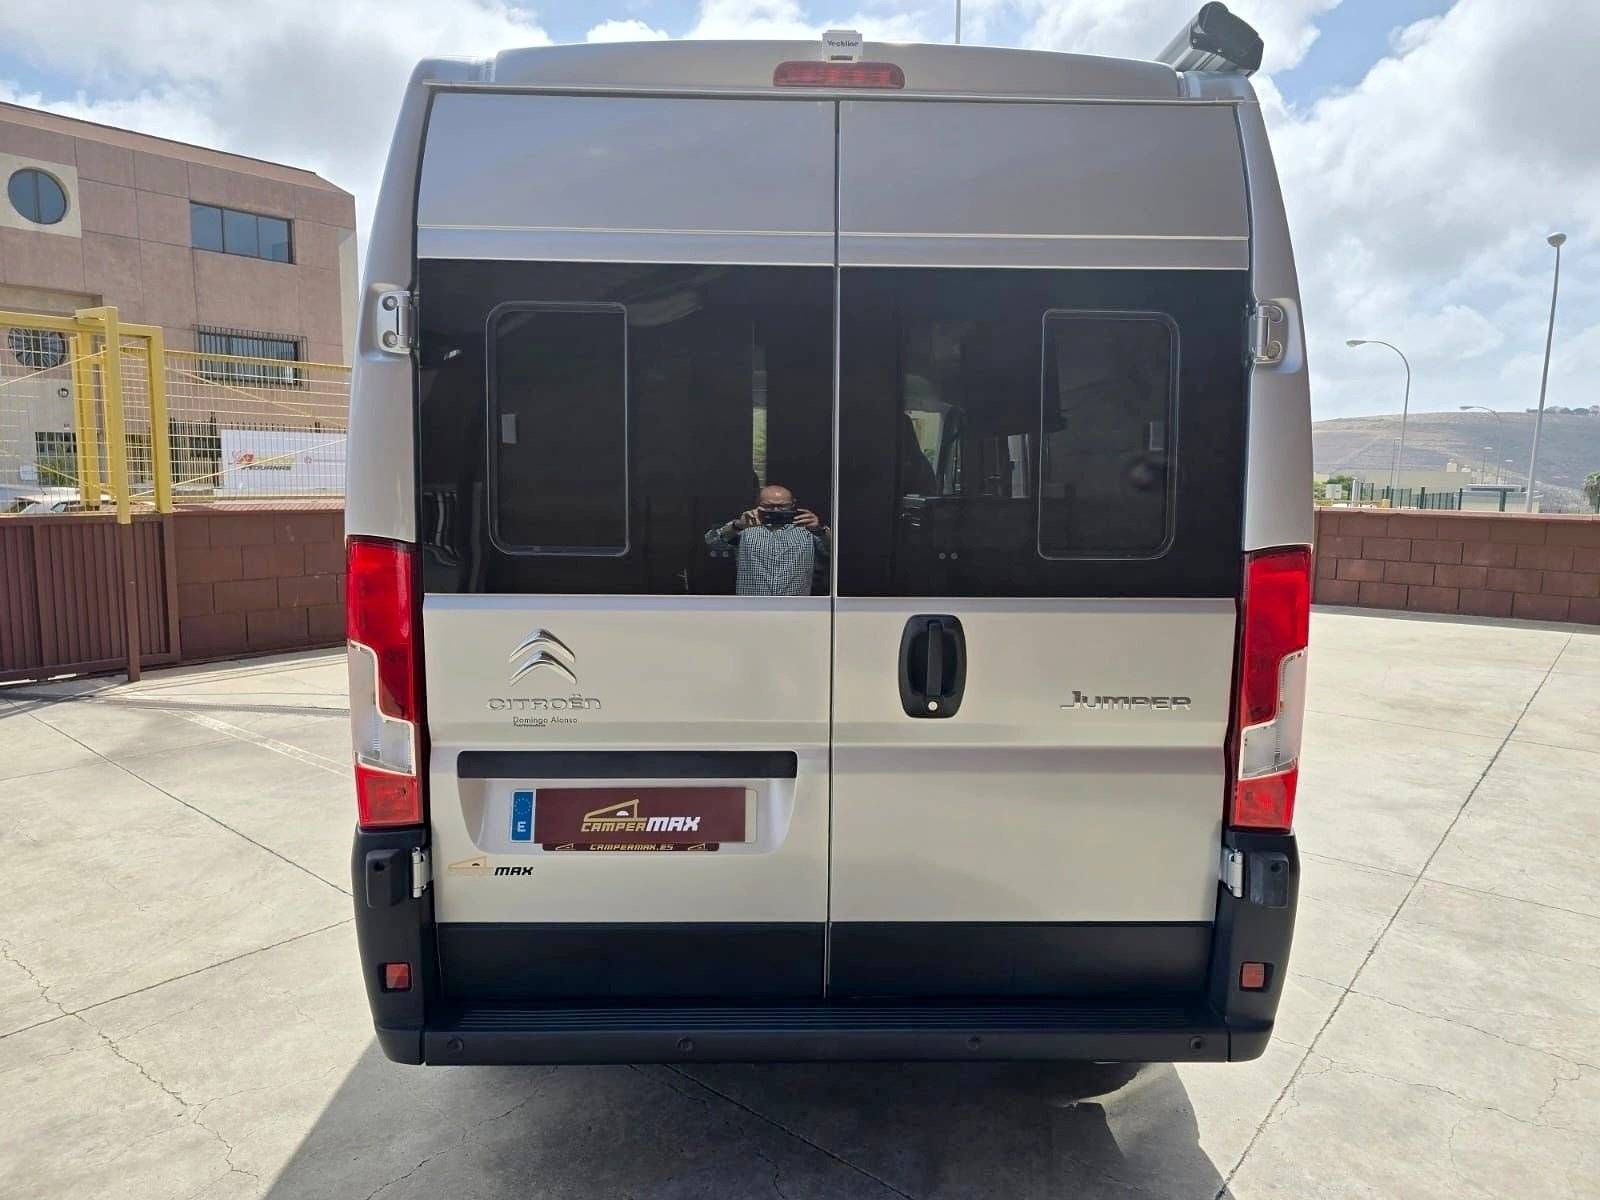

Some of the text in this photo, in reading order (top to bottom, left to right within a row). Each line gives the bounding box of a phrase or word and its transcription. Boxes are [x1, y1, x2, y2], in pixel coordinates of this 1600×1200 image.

[512, 716, 578, 725] Domingo Alonso
[517, 821, 527, 832] E
[494, 866, 534, 876] MAX
